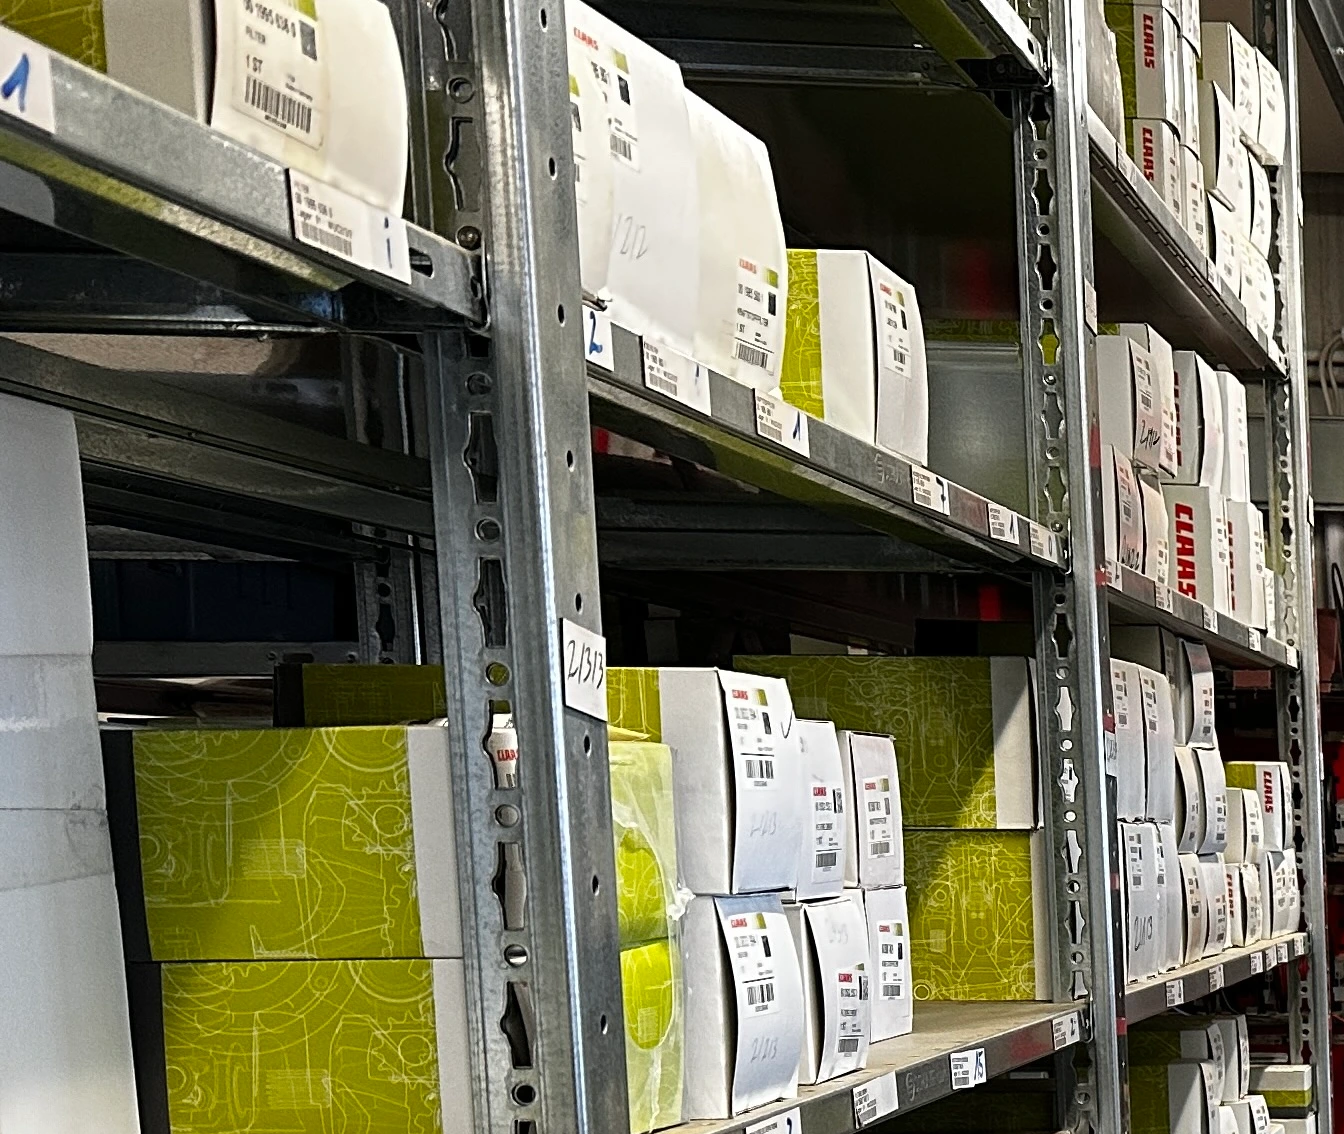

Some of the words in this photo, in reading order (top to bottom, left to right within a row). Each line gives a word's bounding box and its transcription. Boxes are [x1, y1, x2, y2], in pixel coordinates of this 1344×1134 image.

[1142, 13, 1155, 70] CLAAS
[1142, 127, 1155, 182] CLAAS
[1174, 503, 1197, 599] CLAAS
[1264, 771, 1273, 813] CLAAS
